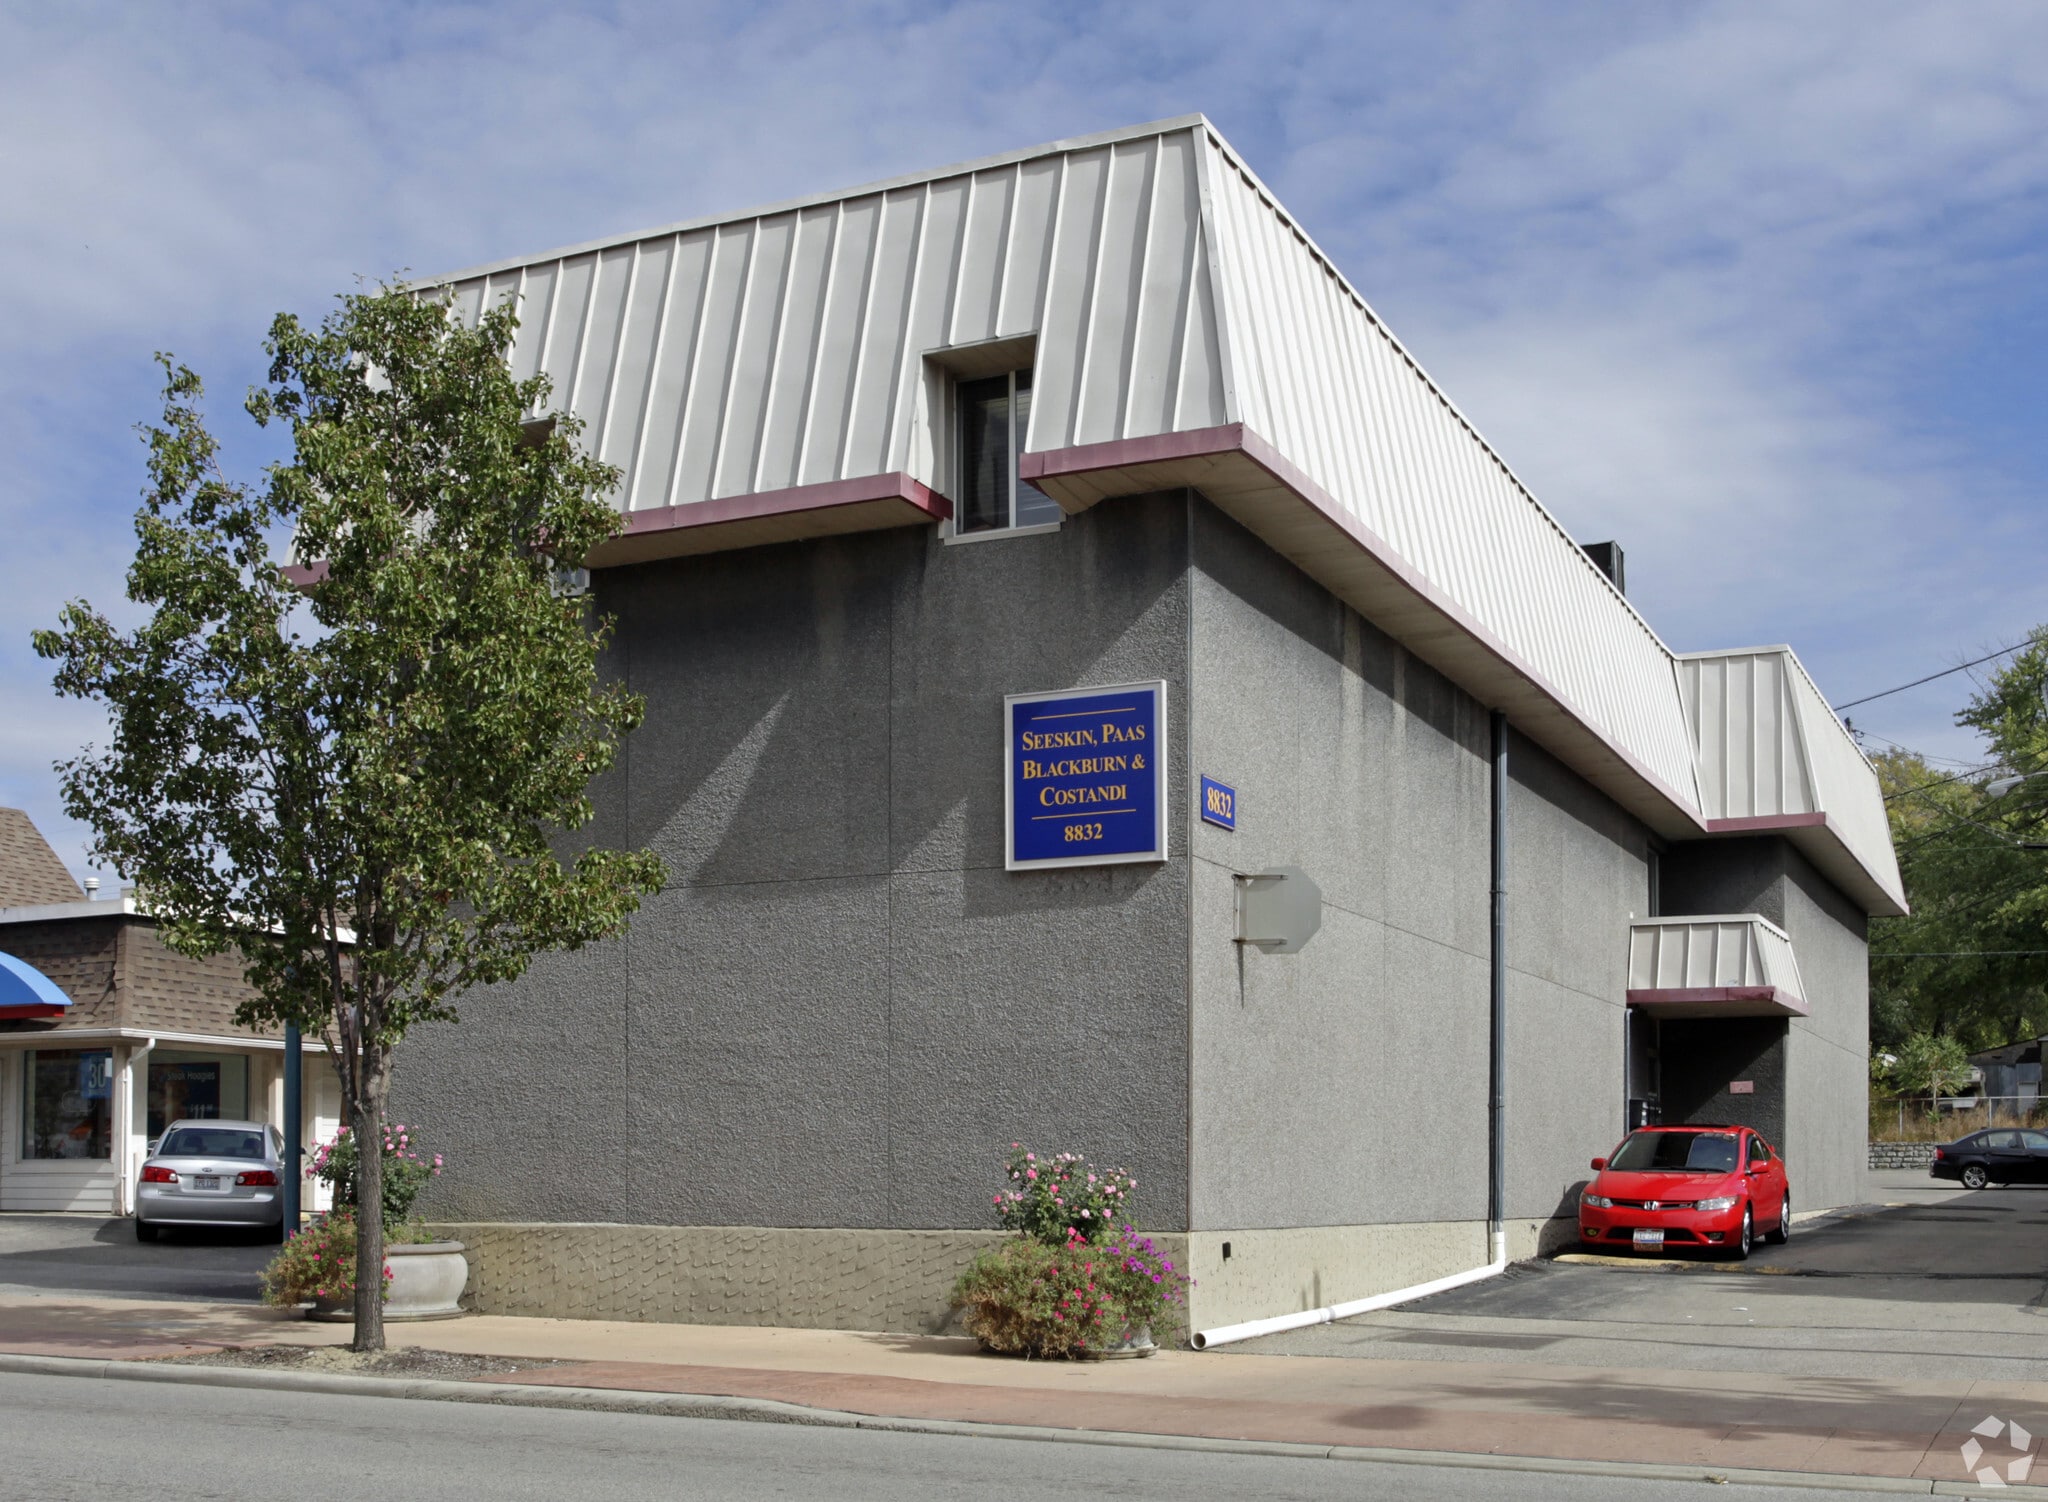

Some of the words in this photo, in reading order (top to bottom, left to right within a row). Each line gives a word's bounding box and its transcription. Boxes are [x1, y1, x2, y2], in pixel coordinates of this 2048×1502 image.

[1022, 729, 1098, 751] SEESKIN,
[1102, 723, 1146, 744] PAAS
[1022, 755, 1127, 780] BLACKBURN
[1131, 753, 1146, 770] &
[1039, 784, 1127, 807] COSTANDI
[1207, 786, 1232, 819] 8832
[1064, 823, 1103, 842] 8832
